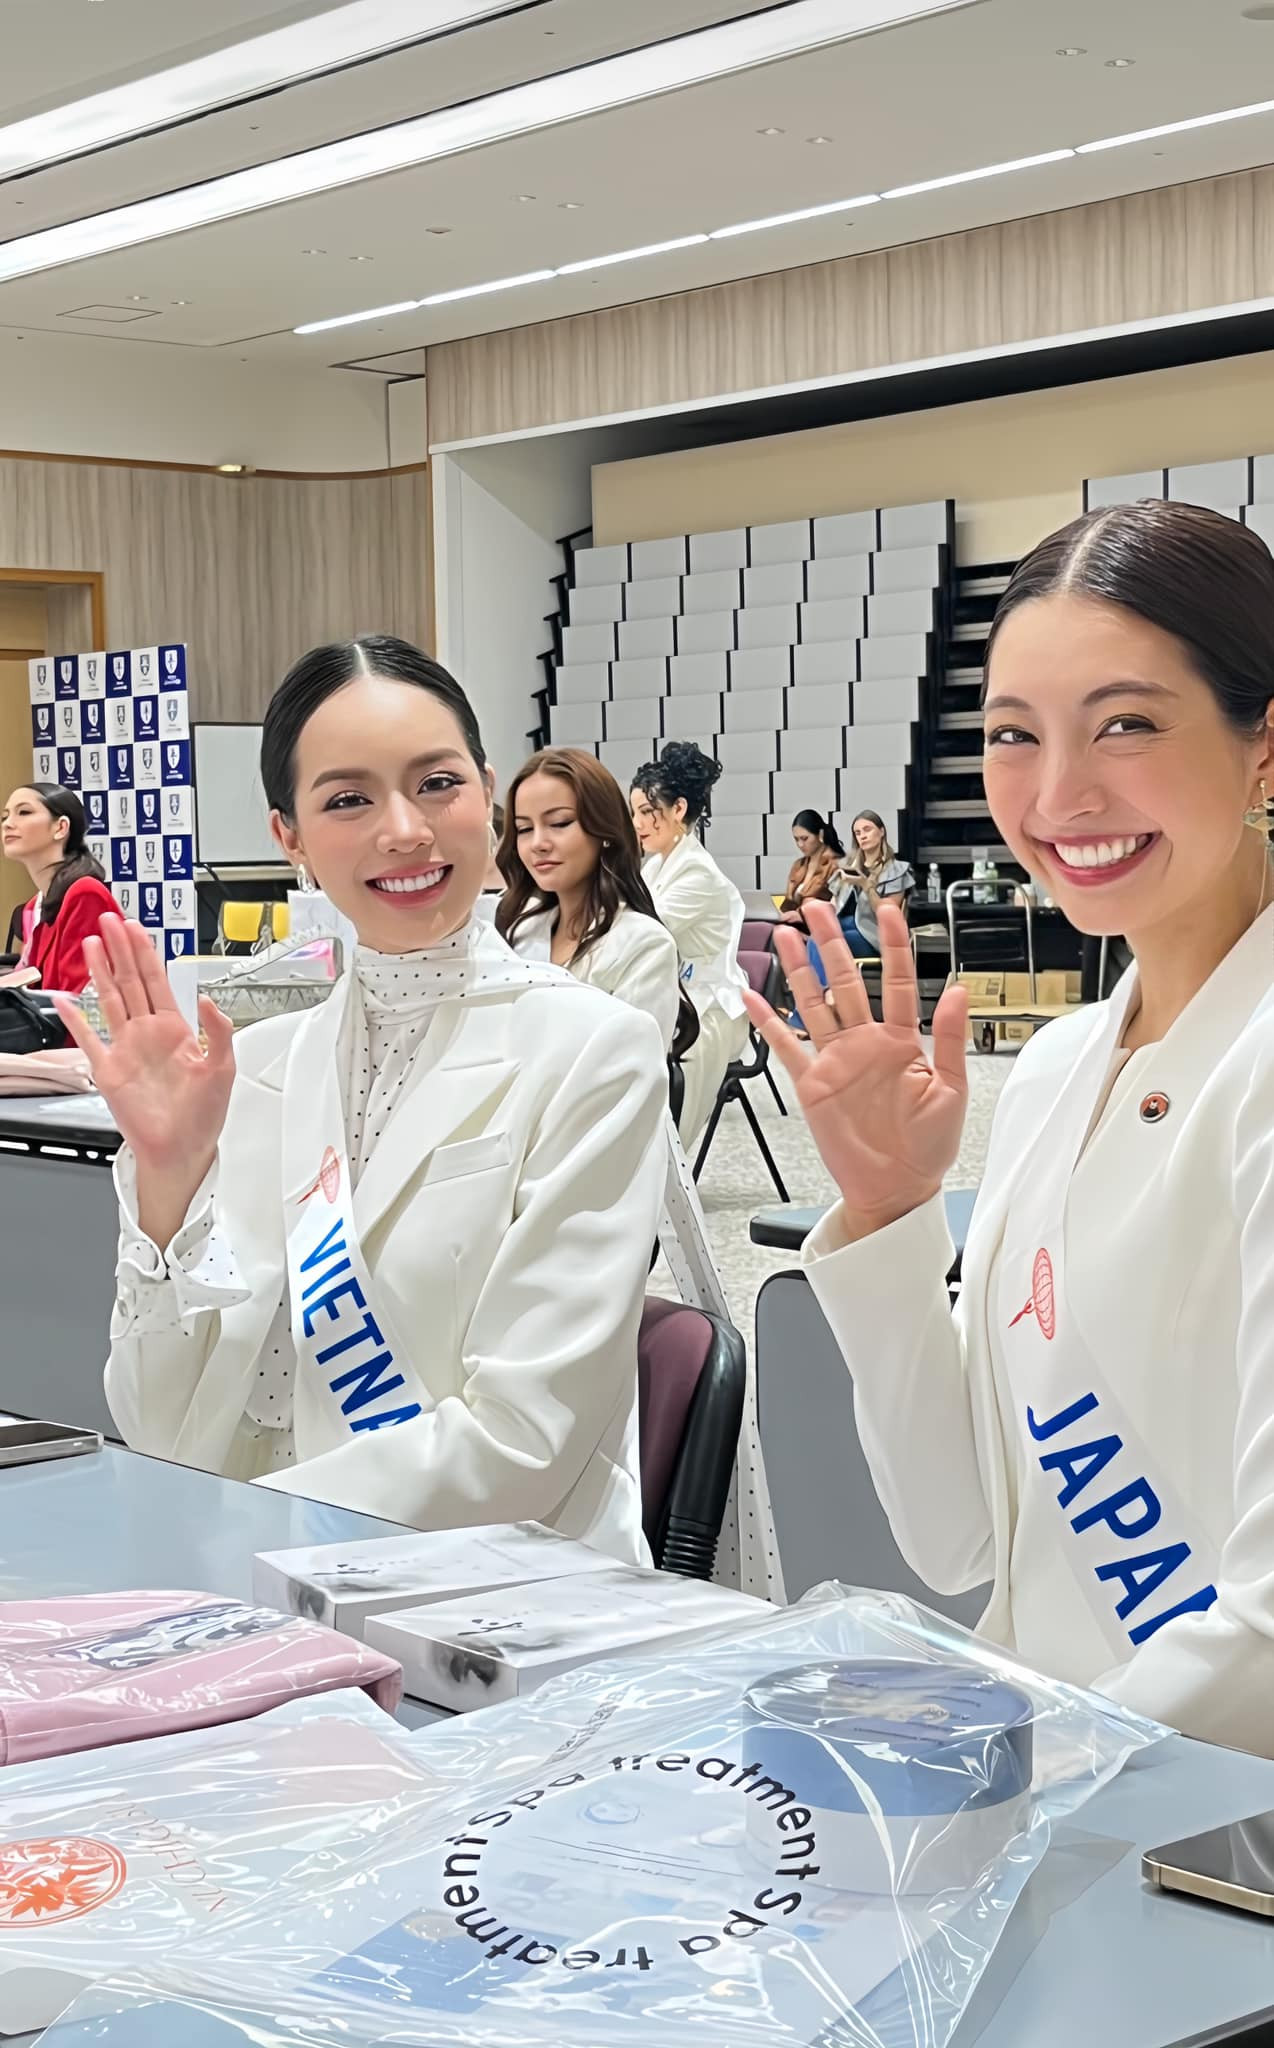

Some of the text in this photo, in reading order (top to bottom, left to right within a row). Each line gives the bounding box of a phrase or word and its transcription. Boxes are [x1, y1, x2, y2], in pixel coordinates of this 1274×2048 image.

[468, 1773, 586, 1829] Spa
[609, 1752, 820, 1881] treatment
[443, 1833, 655, 1971] treatment
[678, 1887, 803, 1957] Spa
